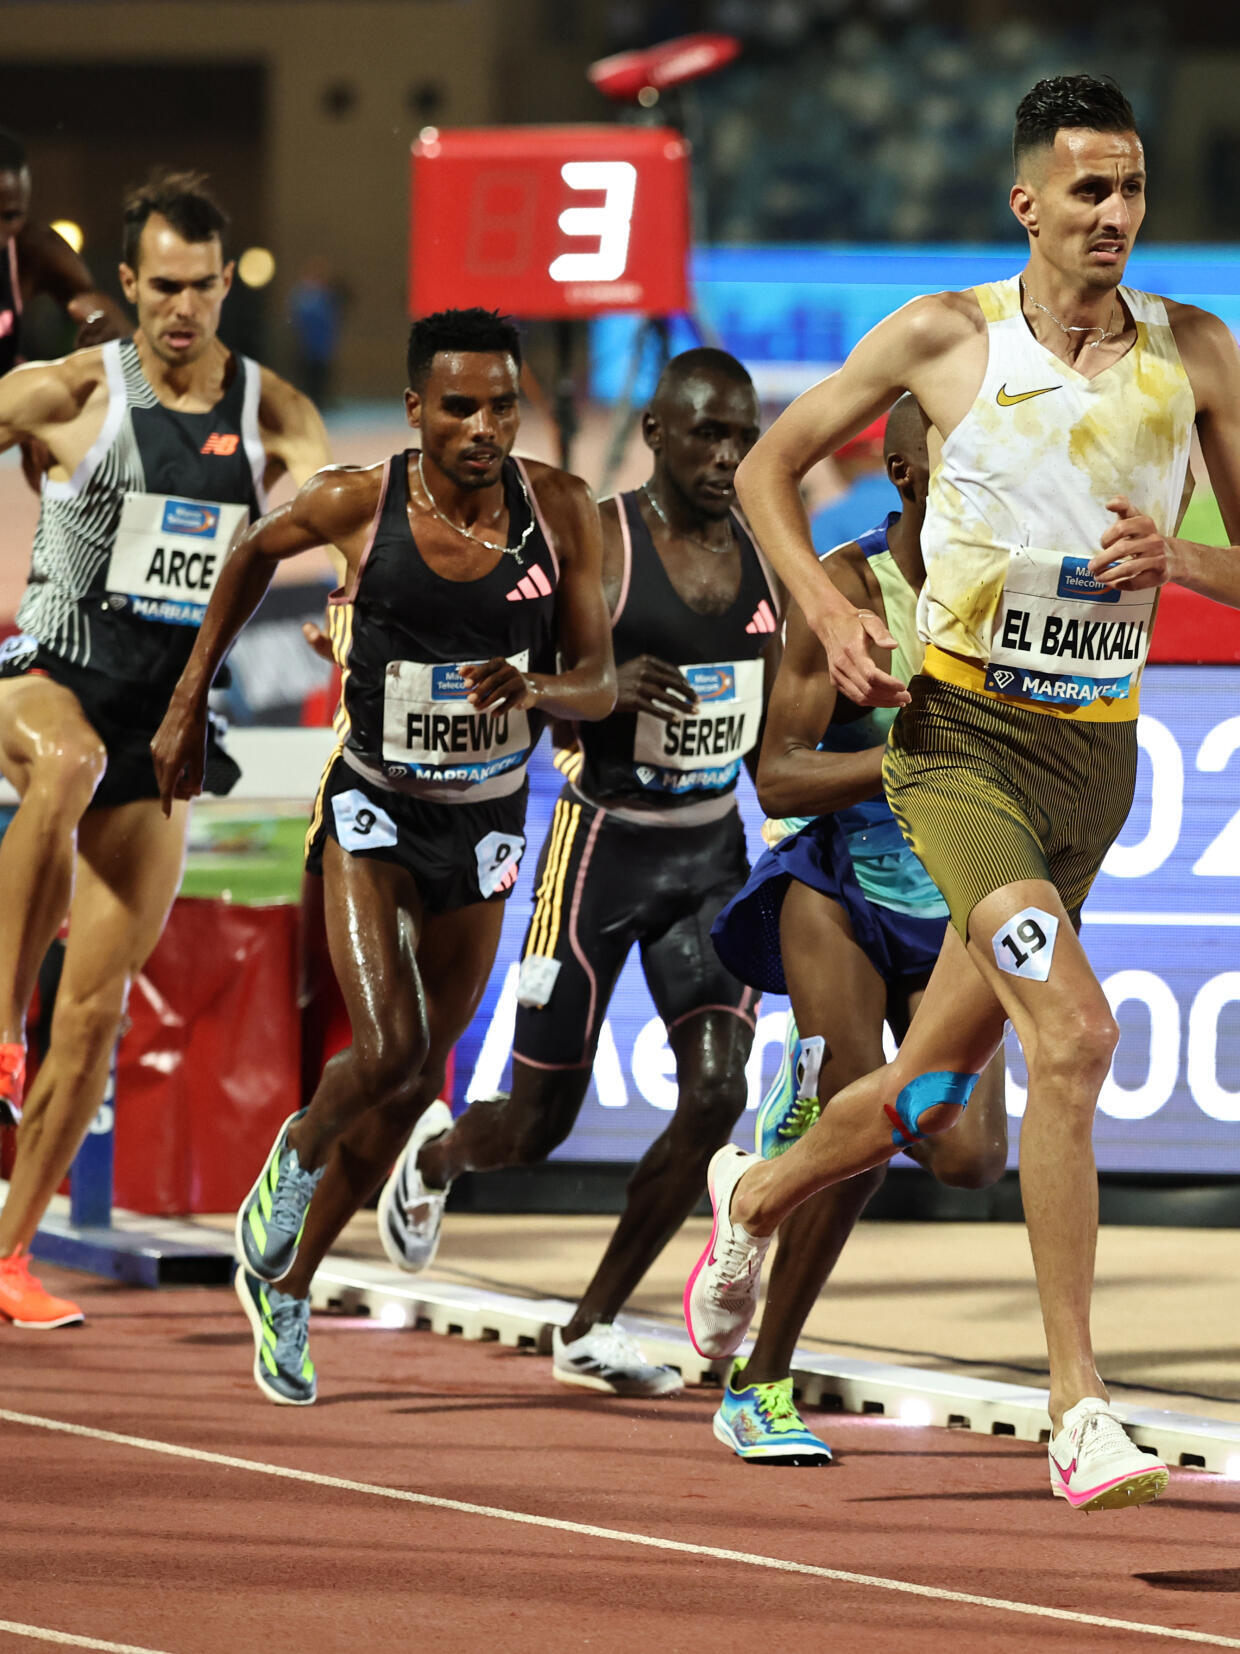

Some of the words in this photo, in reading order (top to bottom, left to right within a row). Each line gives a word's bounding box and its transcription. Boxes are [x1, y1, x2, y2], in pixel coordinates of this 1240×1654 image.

[549, 161, 637, 281] 3
[146, 548, 216, 590] ARCE
[1001, 609, 1032, 651] EL
[1040, 616, 1144, 660] BAKKALI
[406, 712, 509, 752] FIREWU
[664, 714, 745, 756] SEREM
[352, 808, 377, 835] 9
[1001, 919, 1047, 969] 19
